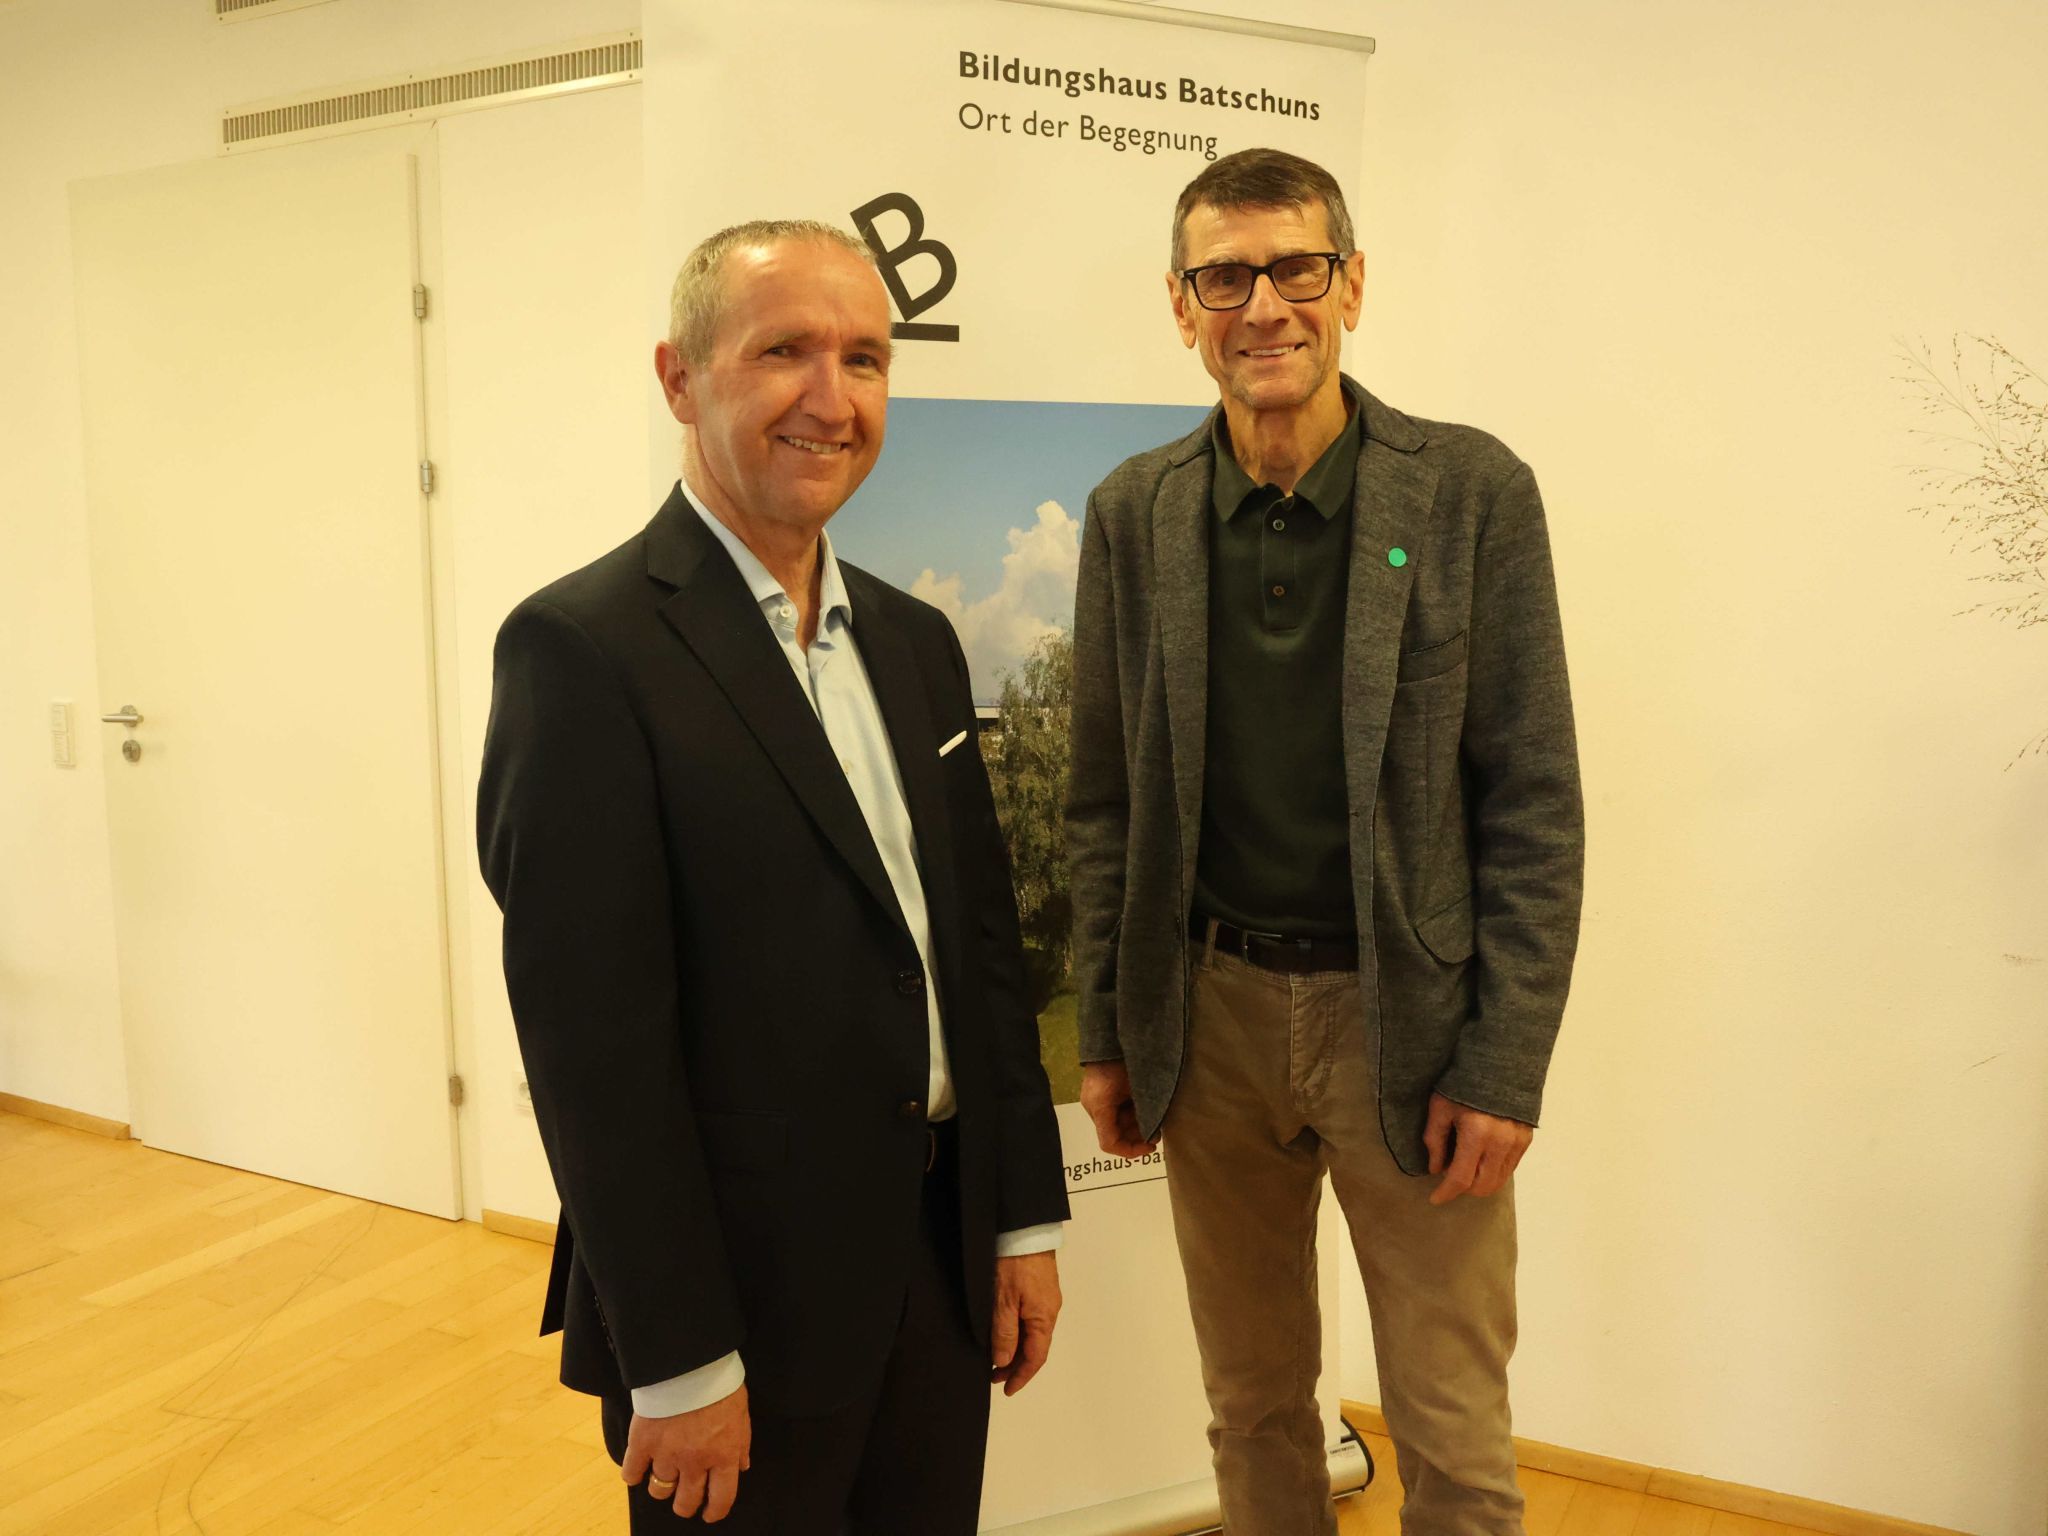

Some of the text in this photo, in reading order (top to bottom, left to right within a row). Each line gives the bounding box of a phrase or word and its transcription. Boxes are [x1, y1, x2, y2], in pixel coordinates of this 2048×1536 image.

[960, 51, 1320, 121] Bildungshaus Batschuns
[959, 103, 1218, 161] Ort der Begegnung
